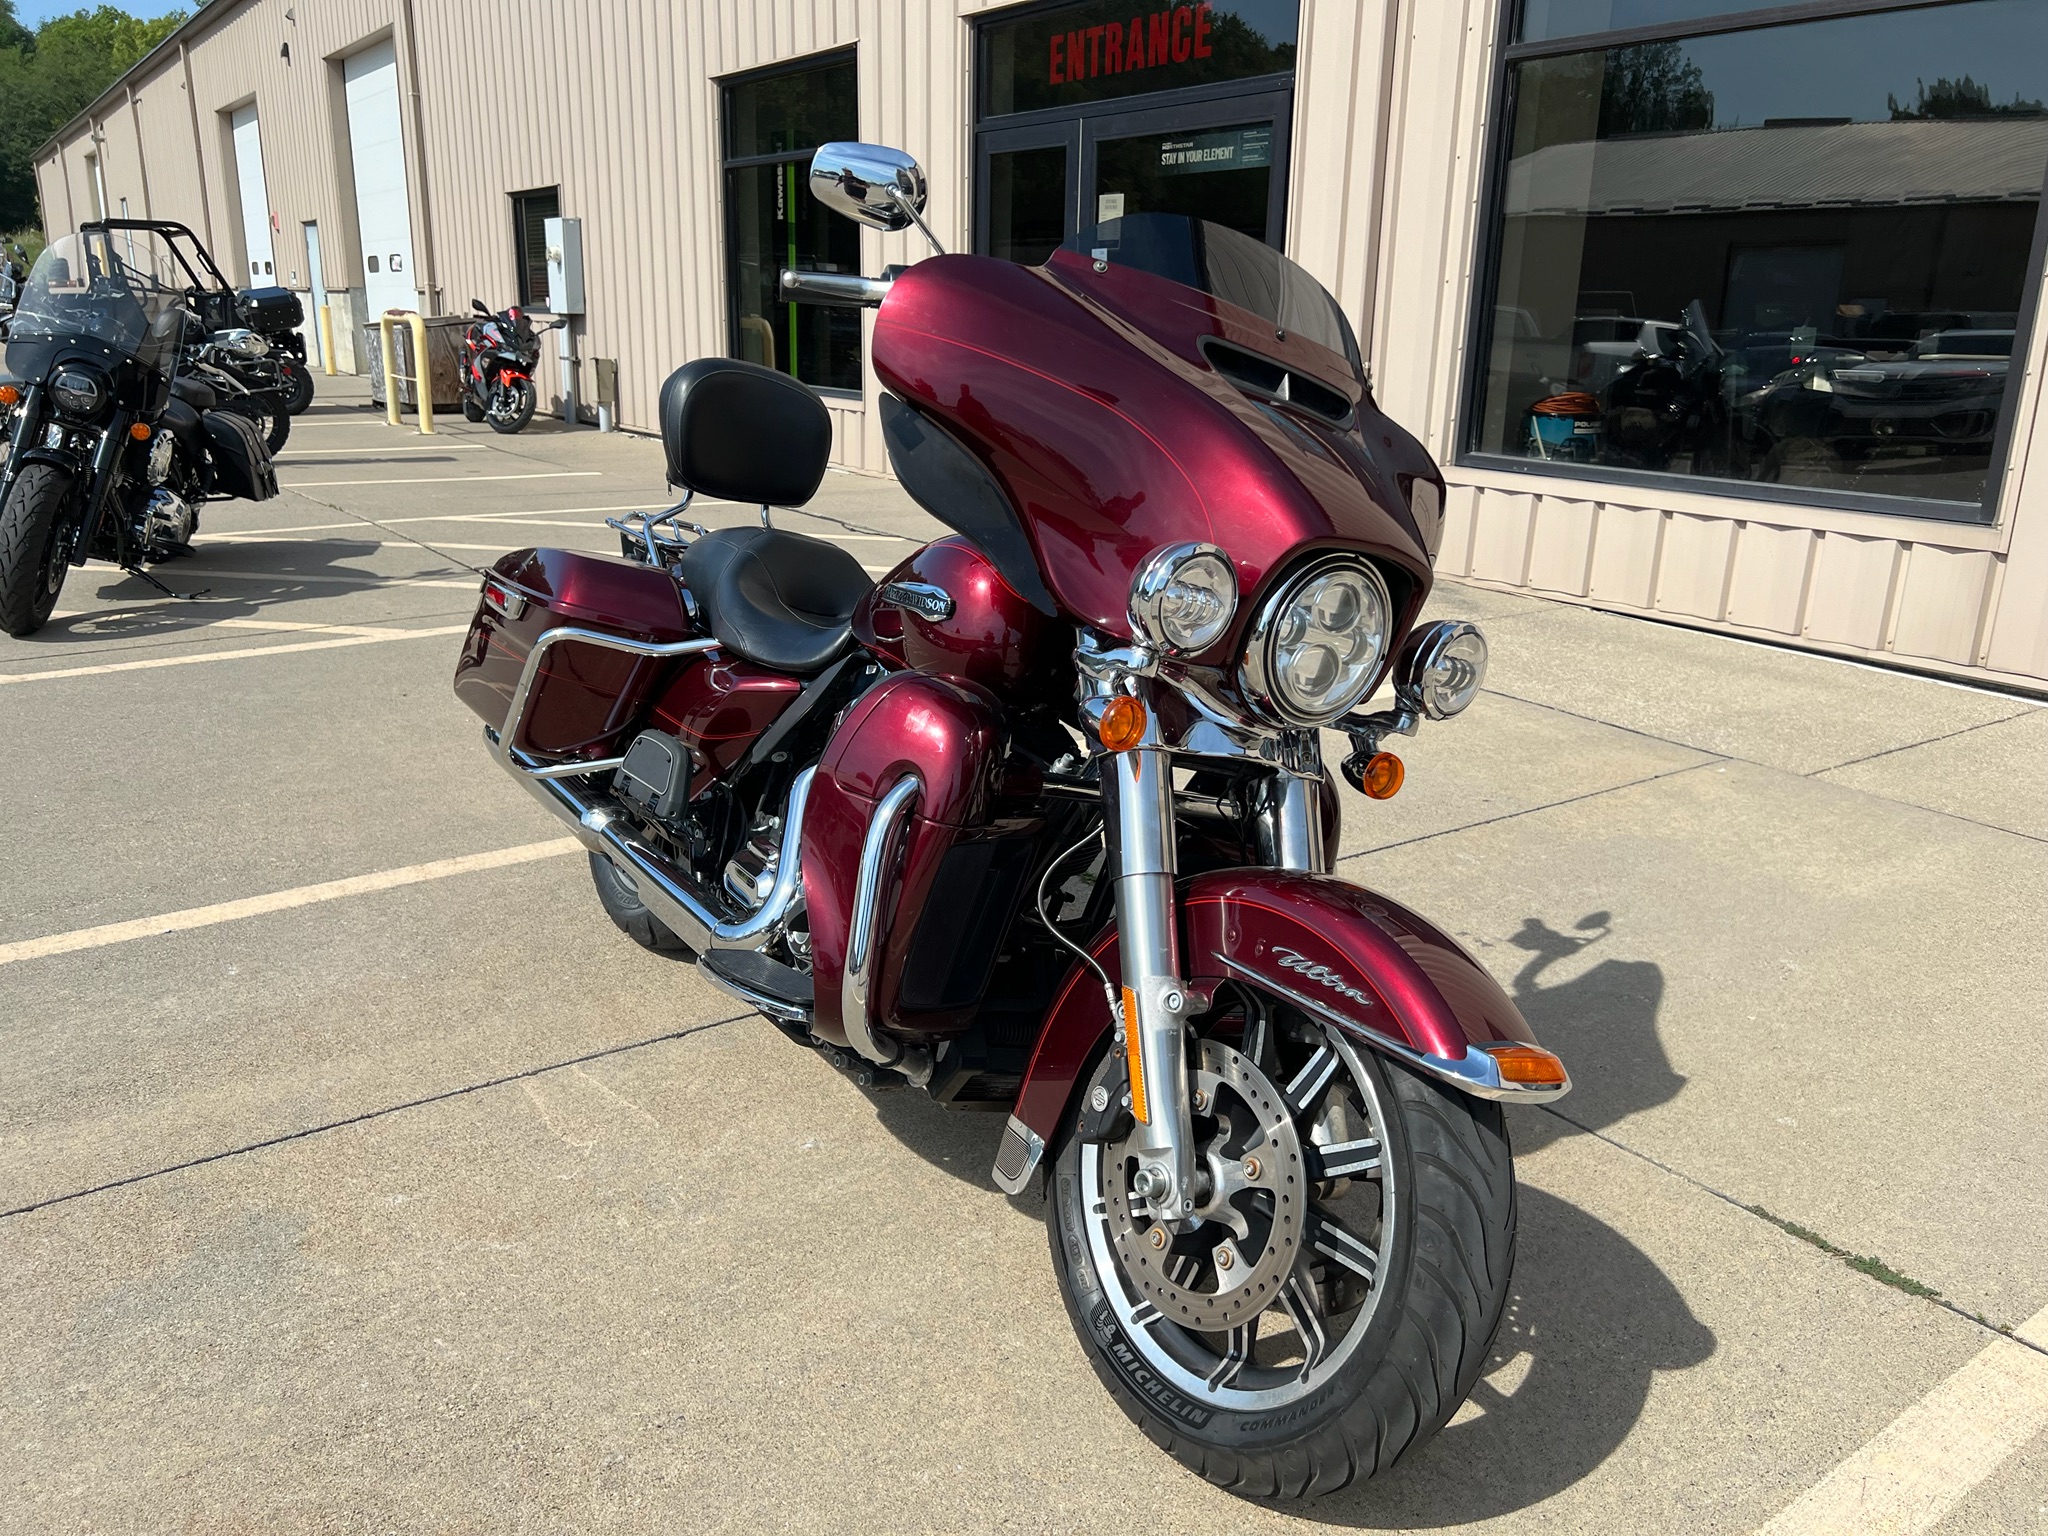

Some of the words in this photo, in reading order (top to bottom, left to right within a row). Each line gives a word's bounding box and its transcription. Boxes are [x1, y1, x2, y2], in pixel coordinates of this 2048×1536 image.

[1050, 3, 1213, 85] ENTRANCE
[1161, 152, 1178, 166] STAY
[1177, 151, 1185, 164] IN
[1186, 149, 1203, 163] YOUR
[1203, 146, 1235, 161] ELEMENT
[1271, 946, 1372, 1005] Ultra
[1112, 1343, 1208, 1423] MICHELIN
